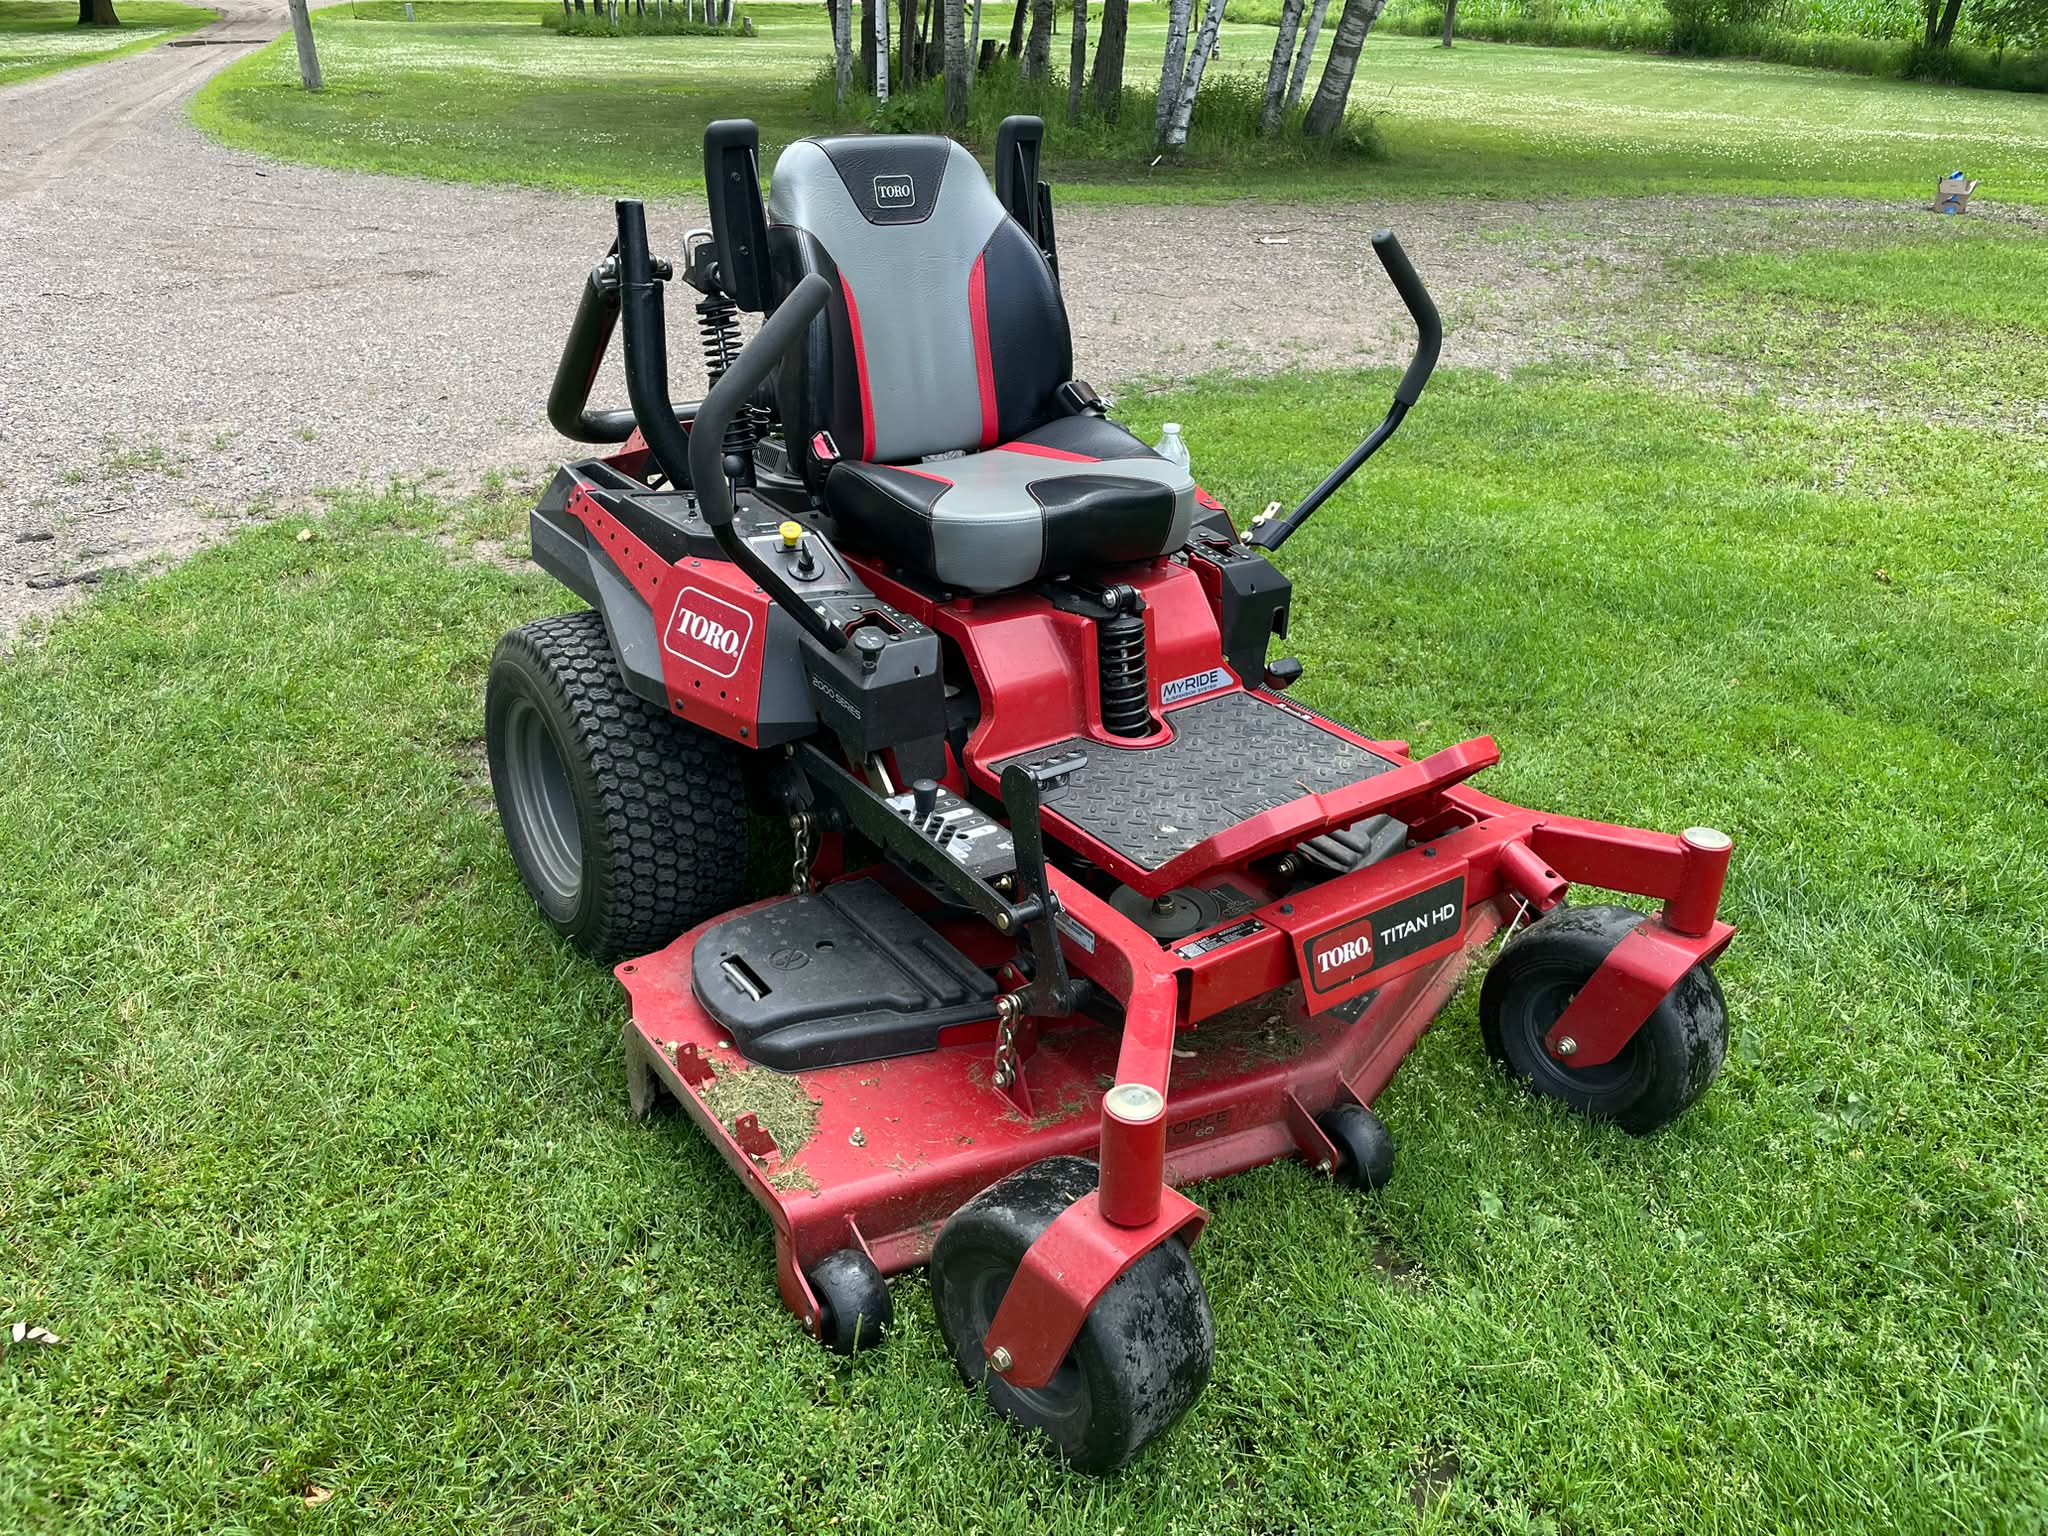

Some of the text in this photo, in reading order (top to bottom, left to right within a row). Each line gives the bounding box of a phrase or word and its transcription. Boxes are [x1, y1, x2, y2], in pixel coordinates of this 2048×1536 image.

[878, 184, 910, 198] TORO
[1380, 914, 1428, 946] TITAN
[1432, 903, 1455, 925] HD
